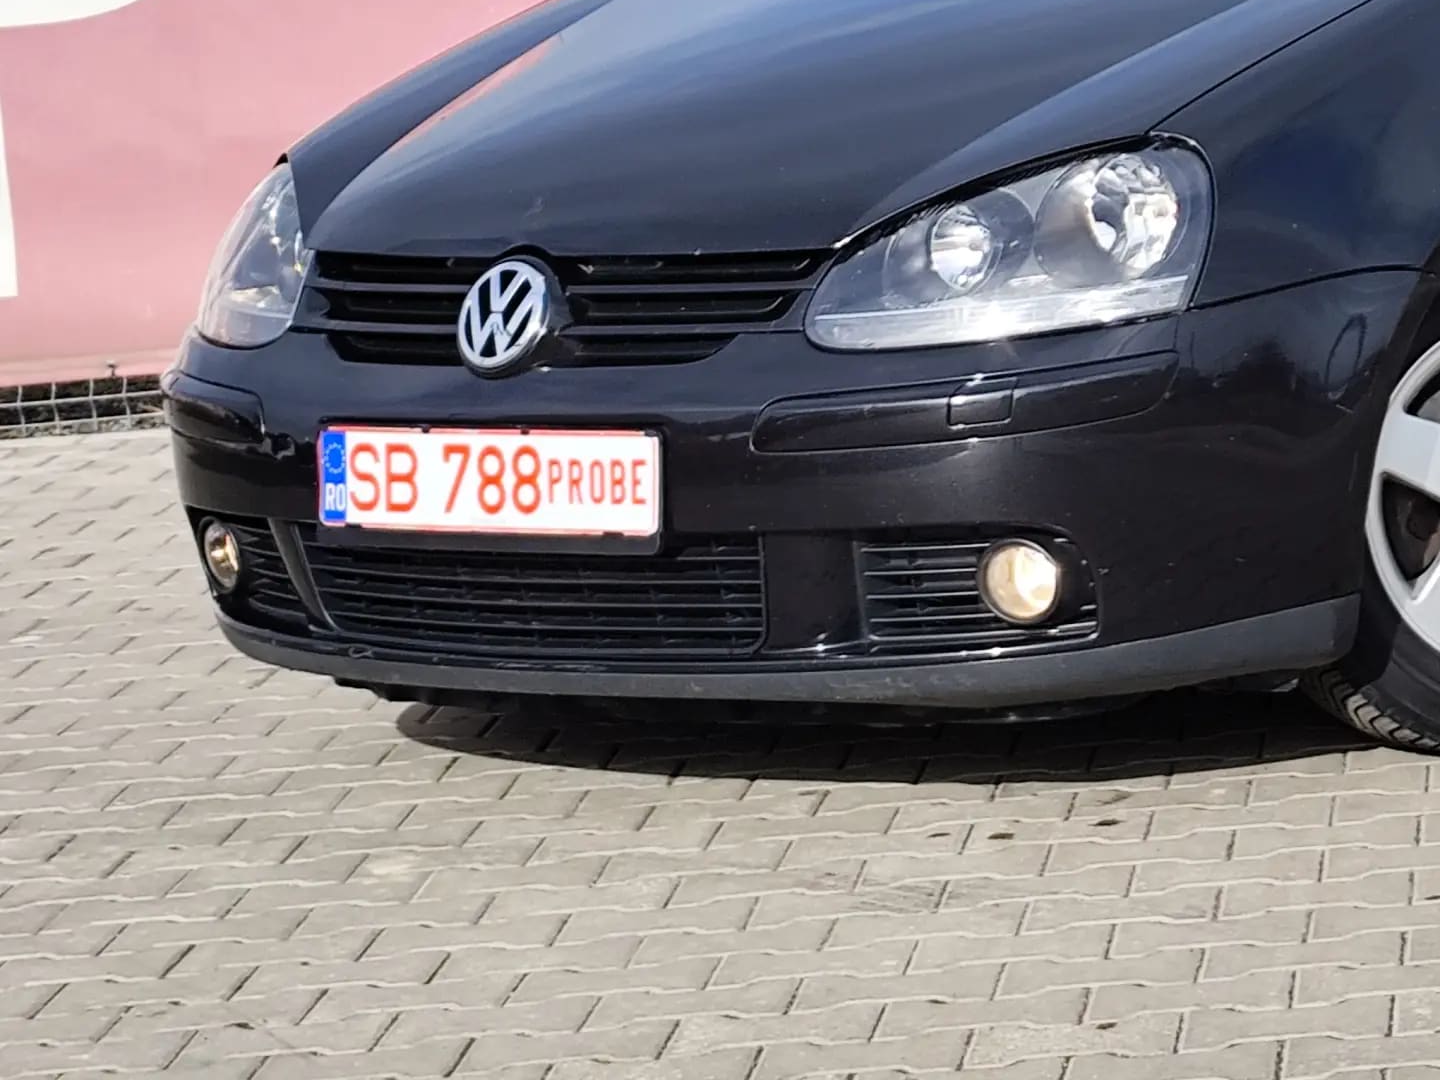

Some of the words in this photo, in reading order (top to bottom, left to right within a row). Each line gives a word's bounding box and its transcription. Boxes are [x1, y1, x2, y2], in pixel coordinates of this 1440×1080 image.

[325, 482, 346, 510] RO
[349, 442, 418, 512] SB
[442, 443, 541, 515] 788
[548, 458, 647, 505] PROBE
